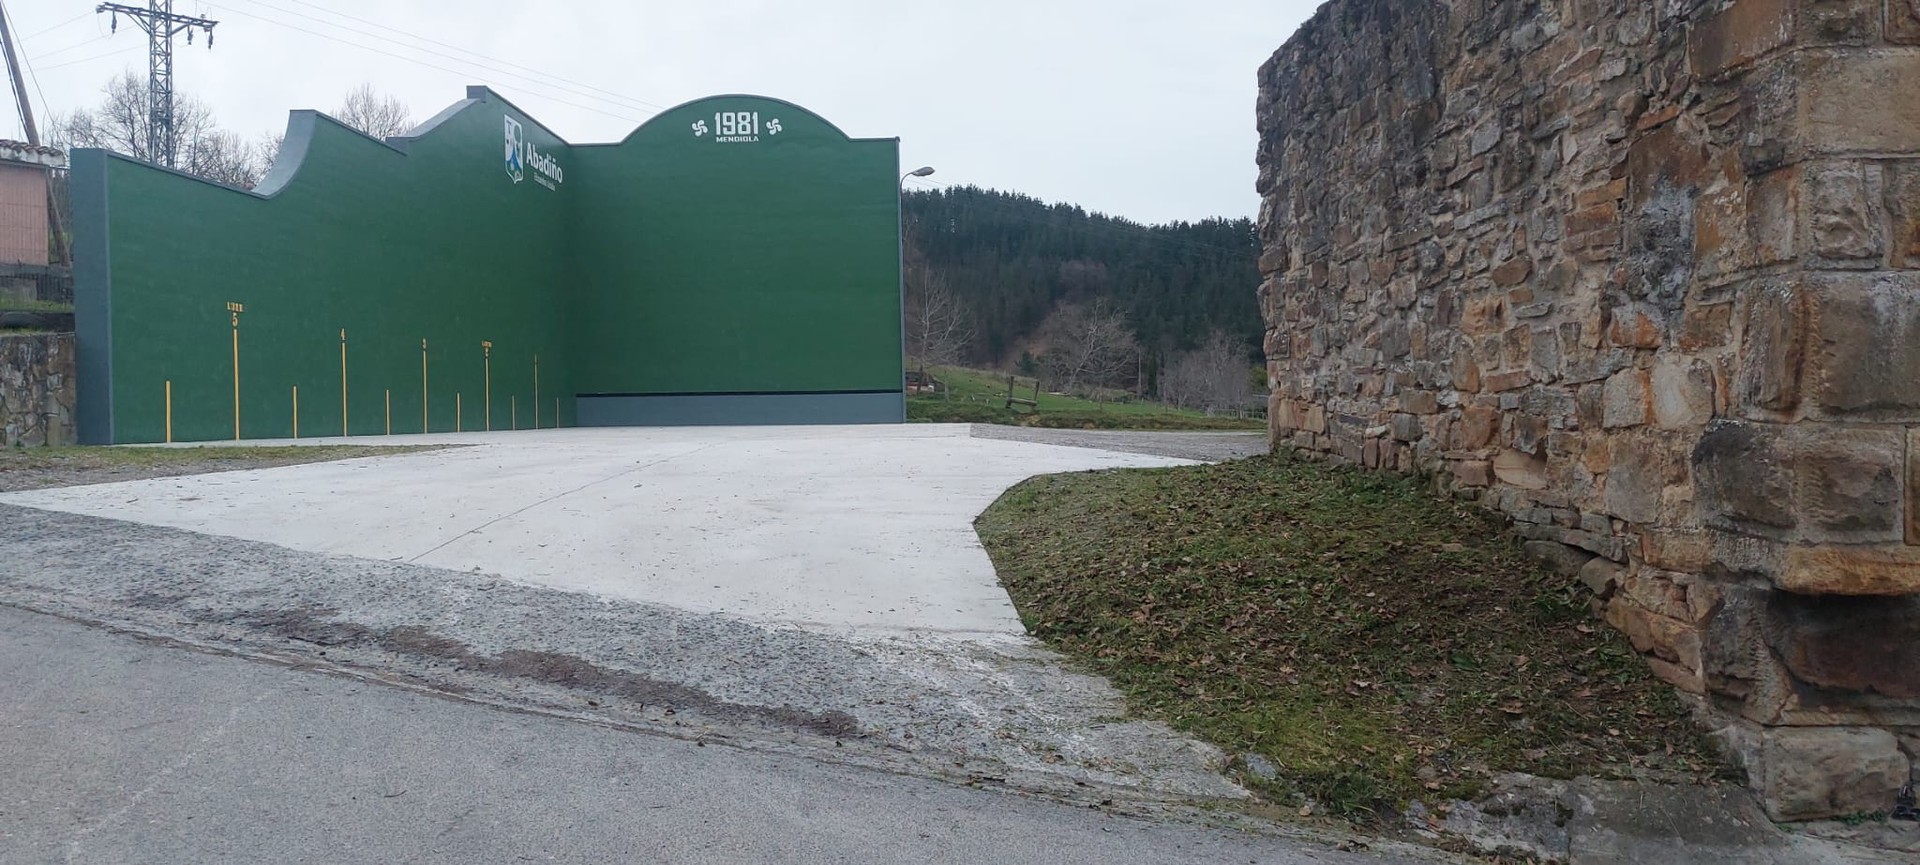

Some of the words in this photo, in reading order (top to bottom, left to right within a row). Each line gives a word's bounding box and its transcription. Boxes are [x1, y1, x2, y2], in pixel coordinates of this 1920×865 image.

[714, 111, 759, 135] 1981
[715, 135, 759, 143] MENDIOLA
[526, 141, 563, 184] Abadiño
